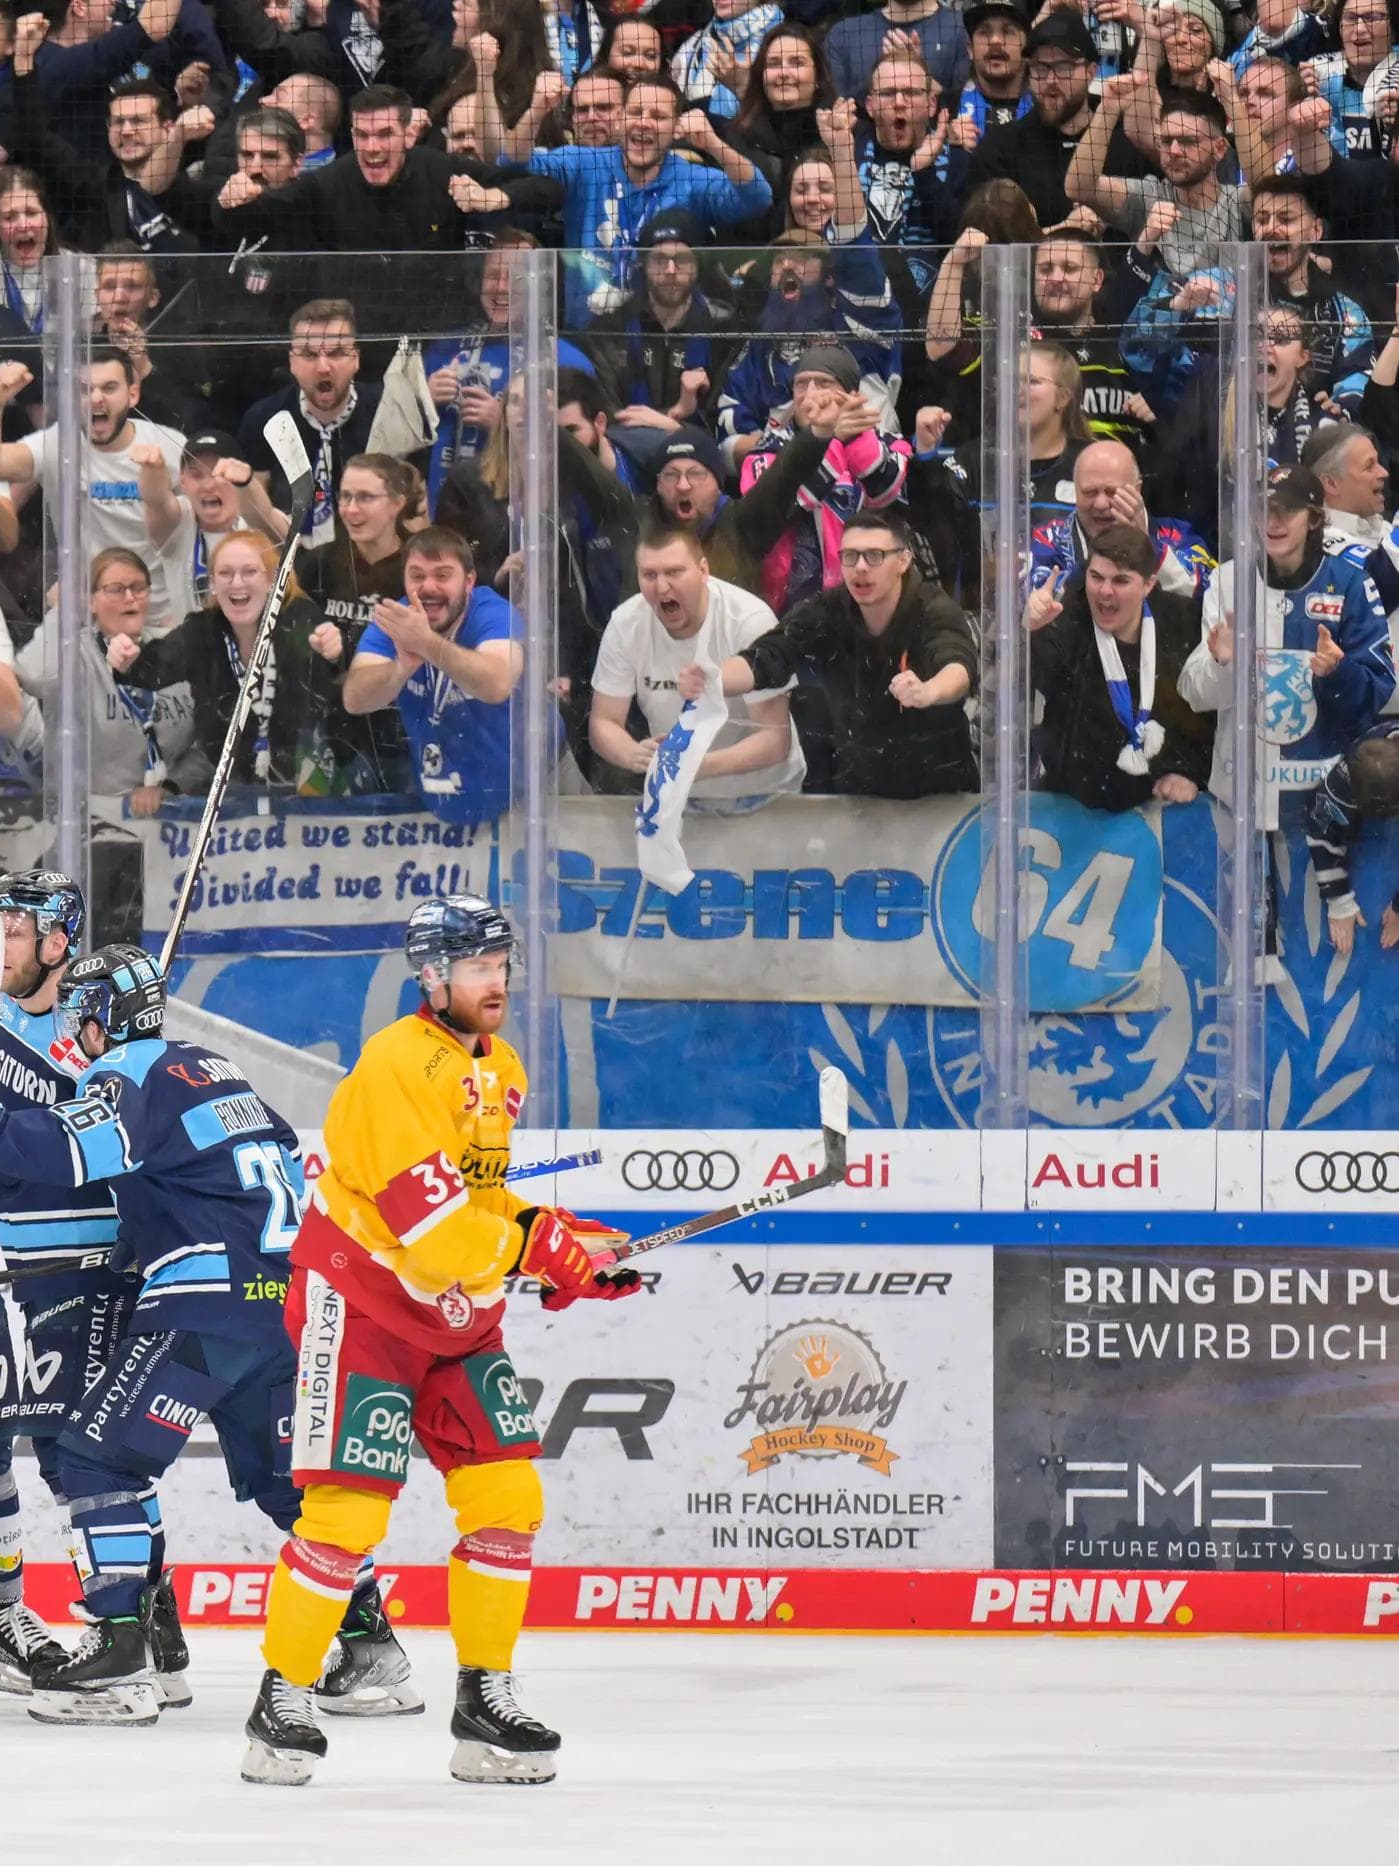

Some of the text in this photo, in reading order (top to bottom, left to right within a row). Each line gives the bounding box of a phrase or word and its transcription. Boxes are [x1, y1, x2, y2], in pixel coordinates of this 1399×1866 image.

[159, 818, 288, 860] Uited
[301, 822, 350, 849] we
[334, 873, 382, 899] we
[512, 849, 924, 942] Szene
[971, 826, 1135, 971] 64
[409, 1149, 465, 1206] 39
[762, 1153, 890, 1189] Adi
[1032, 1153, 1160, 1188] Audi
[736, 1188, 789, 1217] CCM
[628, 1225, 686, 1256] JETSPEED
[1064, 1266, 1399, 1306] BRING DEN PU
[1065, 1322, 1387, 1361] BEWIRB DICH
[20, 1402, 65, 1417] AUER
[308, 1352, 332, 1447] DIGITAL
[723, 1372, 908, 1433] Fairplay
[342, 1436, 409, 1474] Bank
[764, 1428, 877, 1453] Hockey Shop
[686, 1489, 944, 1516] IHR FACHHÄNDLER
[712, 1526, 920, 1549] IN INGOLSTADT
[1065, 1539, 1399, 1561] FUTURE MOBILITY SOLUTI
